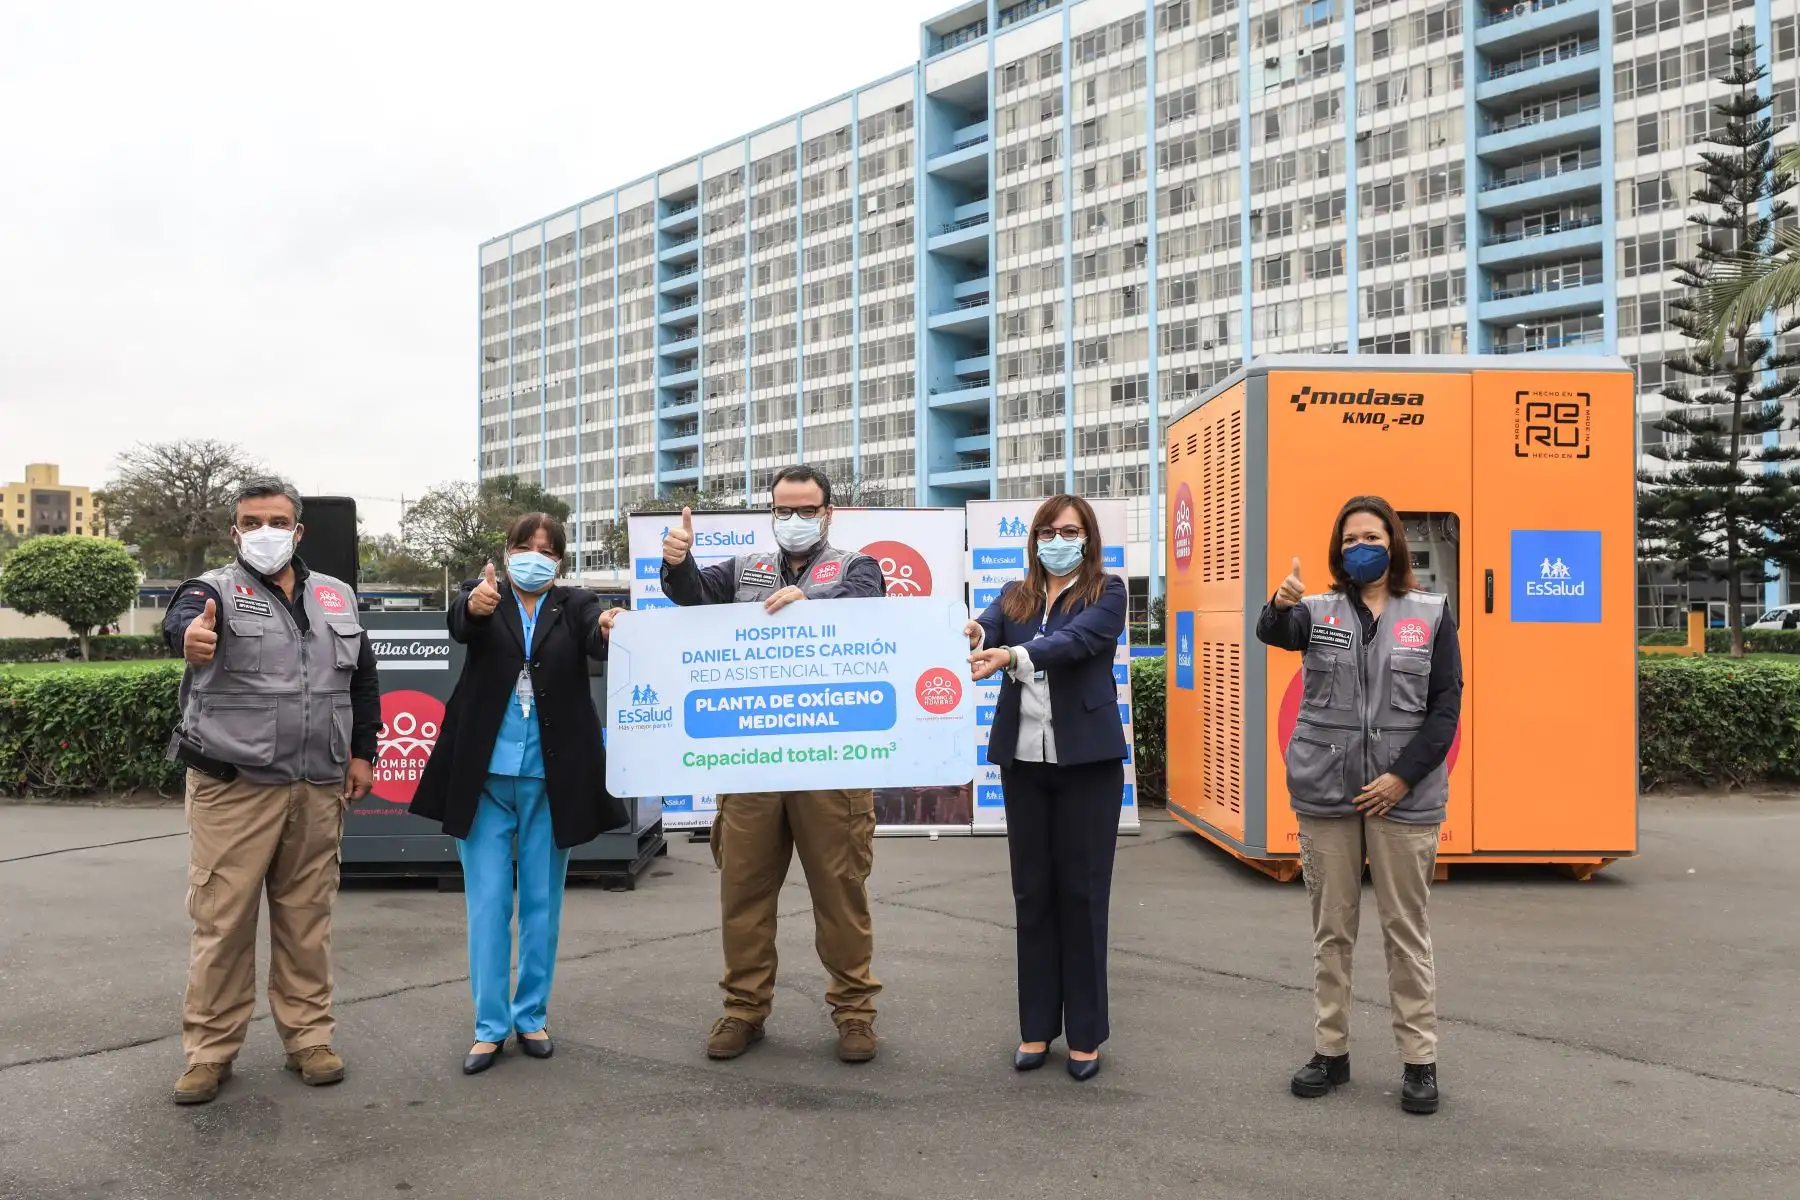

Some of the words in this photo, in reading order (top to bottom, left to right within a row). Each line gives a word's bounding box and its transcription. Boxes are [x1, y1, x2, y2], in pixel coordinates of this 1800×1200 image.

[1310, 388, 1424, 405] modasa
[695, 530, 755, 546] EsSalud
[1526, 581, 1585, 596] EsSalud
[735, 625, 817, 642] HOSPITAL
[821, 624, 836, 638] III
[371, 641, 408, 655] Atlas
[409, 641, 450, 658] Copco
[682, 648, 741, 664] DANIEL
[744, 644, 816, 661] ALCIDES
[819, 638, 897, 657] CARRIÓN
[1178, 653, 1192, 667] EsSalud
[690, 668, 721, 683] RED
[724, 663, 829, 681] ASISTENCIAL
[833, 661, 889, 676] TACNA
[695, 695, 767, 712] PLANTA
[769, 693, 795, 709] DE
[797, 688, 884, 706] OXÍGENO
[618, 705, 673, 724] EsSalud
[738, 711, 840, 730] MEDICINAL
[682, 746, 783, 770] Capacidad
[787, 744, 838, 763] total:
[842, 744, 868, 760] 20
[372, 769, 424, 781] HOMB
[662, 819, 713, 827] www.essalud.gob.p
